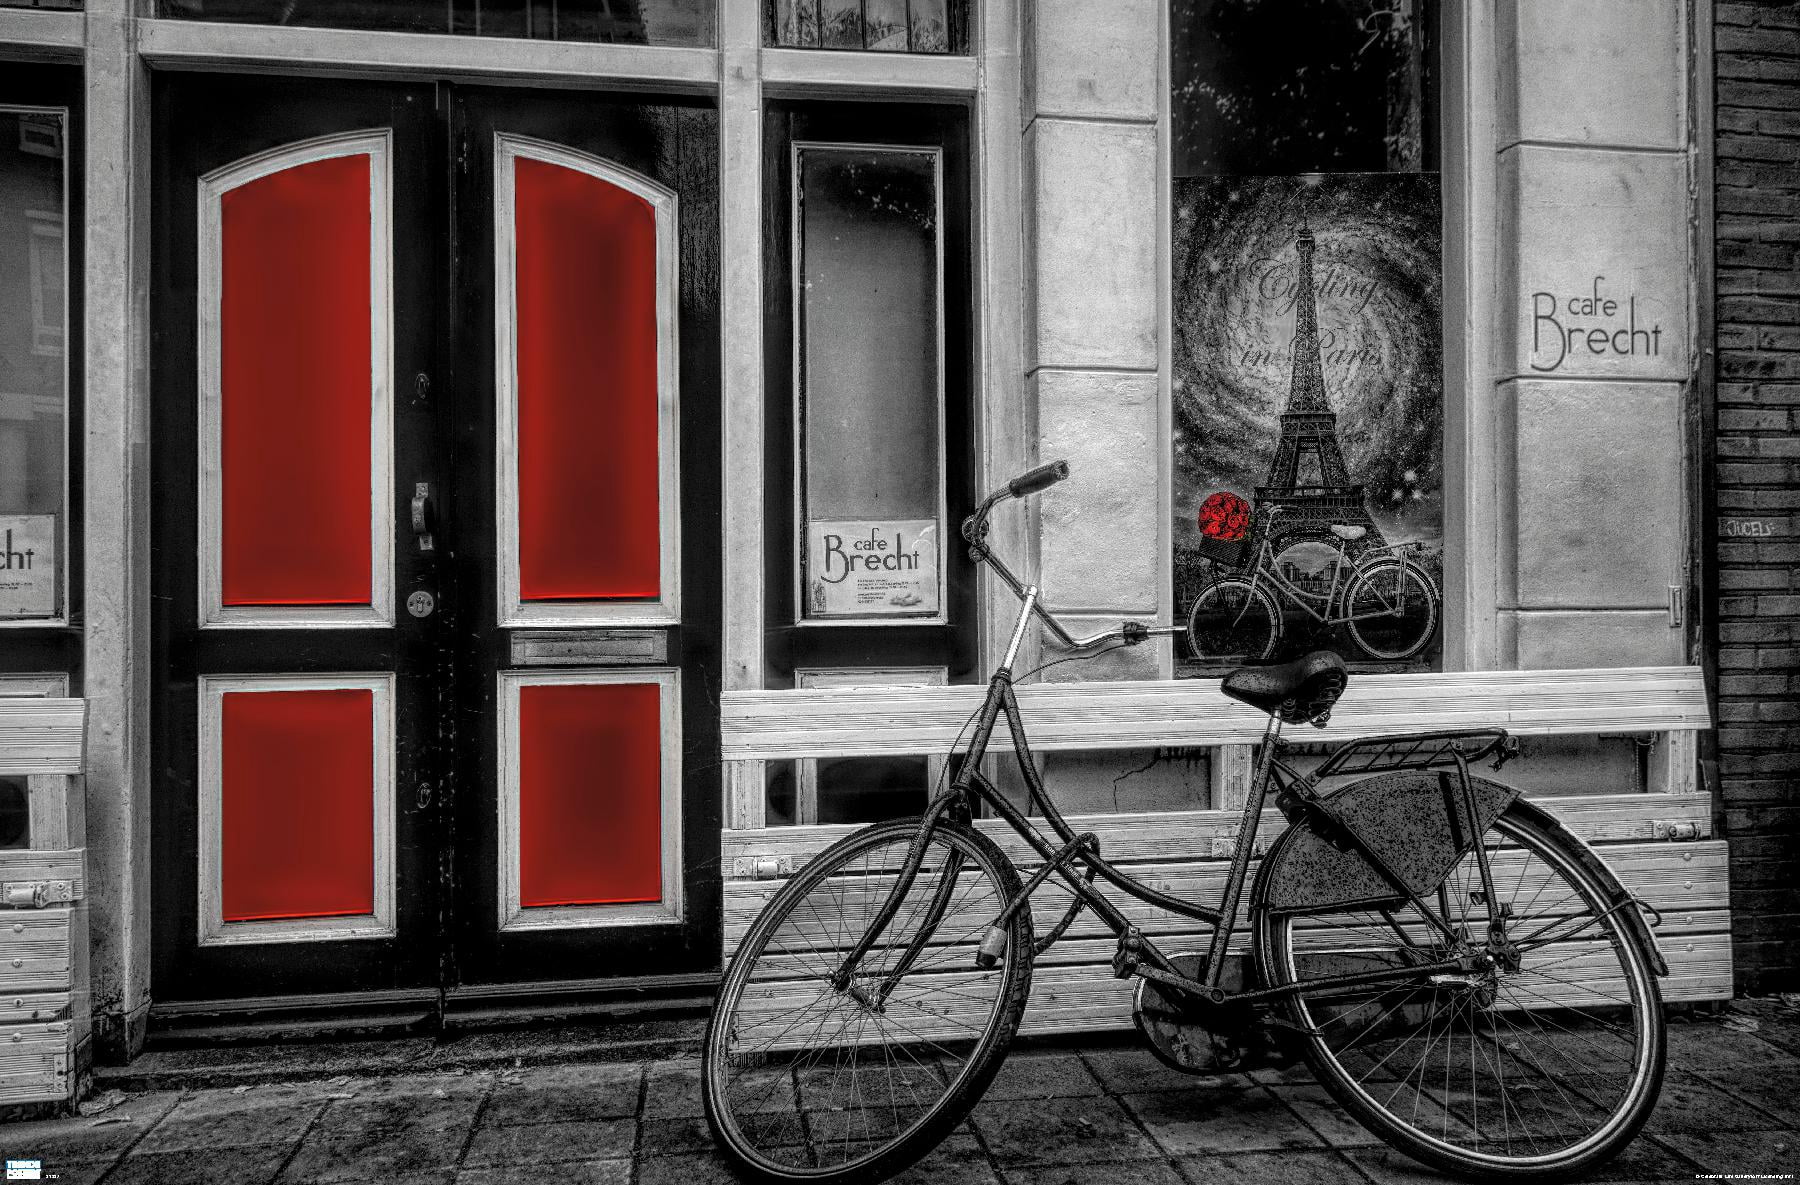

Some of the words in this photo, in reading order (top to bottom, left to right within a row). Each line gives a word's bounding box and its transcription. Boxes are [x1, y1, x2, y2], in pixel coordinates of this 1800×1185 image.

[1568, 276, 1617, 317] cafe
[1531, 292, 1662, 372] Brecht
[1240, 344, 1271, 366] in
[821, 533, 920, 583] Brecht
[853, 527, 888, 551] cafe
